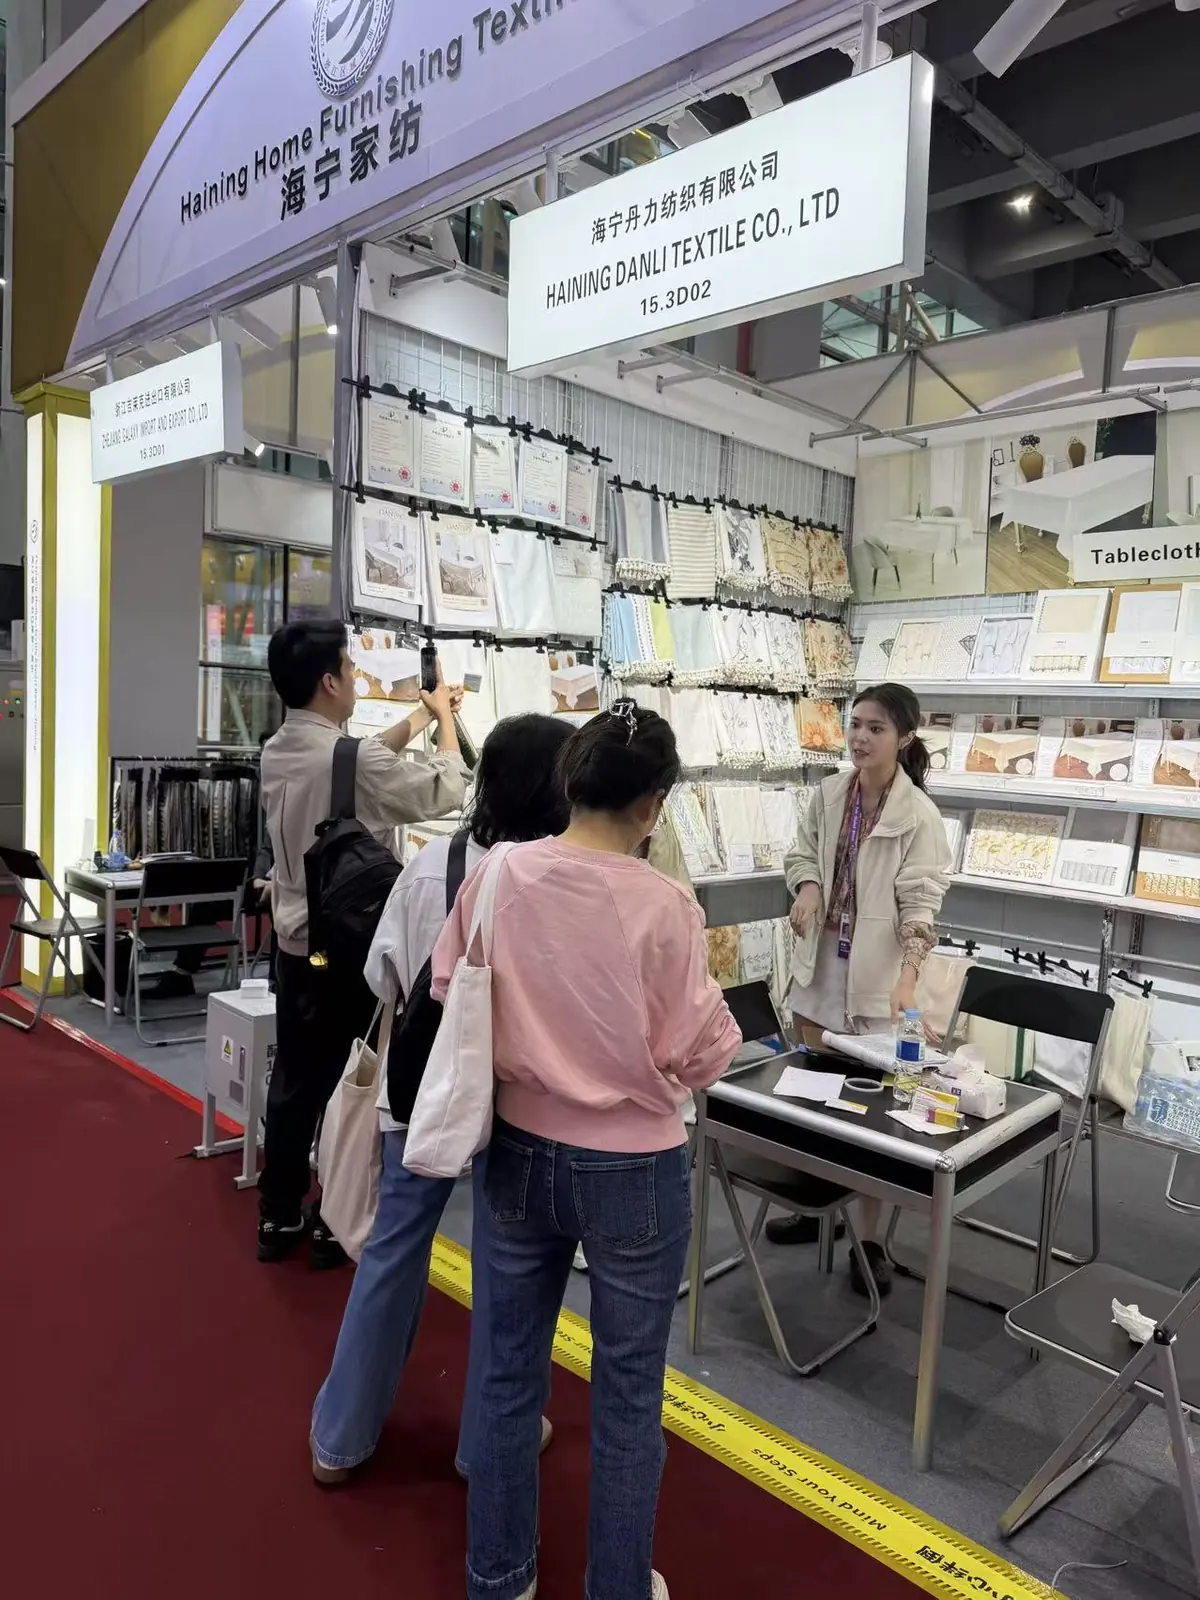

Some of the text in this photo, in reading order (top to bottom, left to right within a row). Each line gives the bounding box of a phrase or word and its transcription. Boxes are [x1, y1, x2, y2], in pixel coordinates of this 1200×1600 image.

[180, 161, 249, 224] Haining
[254, 128, 313, 181] Home
[319, 33, 464, 144] Furnishing
[280, 101, 424, 222] 海宁家纺
[590, 150, 780, 246] 海宁丹力纺织有限公司
[546, 263, 611, 310] HAINING
[615, 245, 667, 288] DANLI
[671, 217, 746, 268] TEXTILE
[799, 186, 841, 228] LTD
[639, 279, 712, 317] 15.3D02
[157, 415, 167, 432] AND
[168, 409, 187, 429] EXPORT
[750, 1447, 888, 1532] Mind Your Steps
